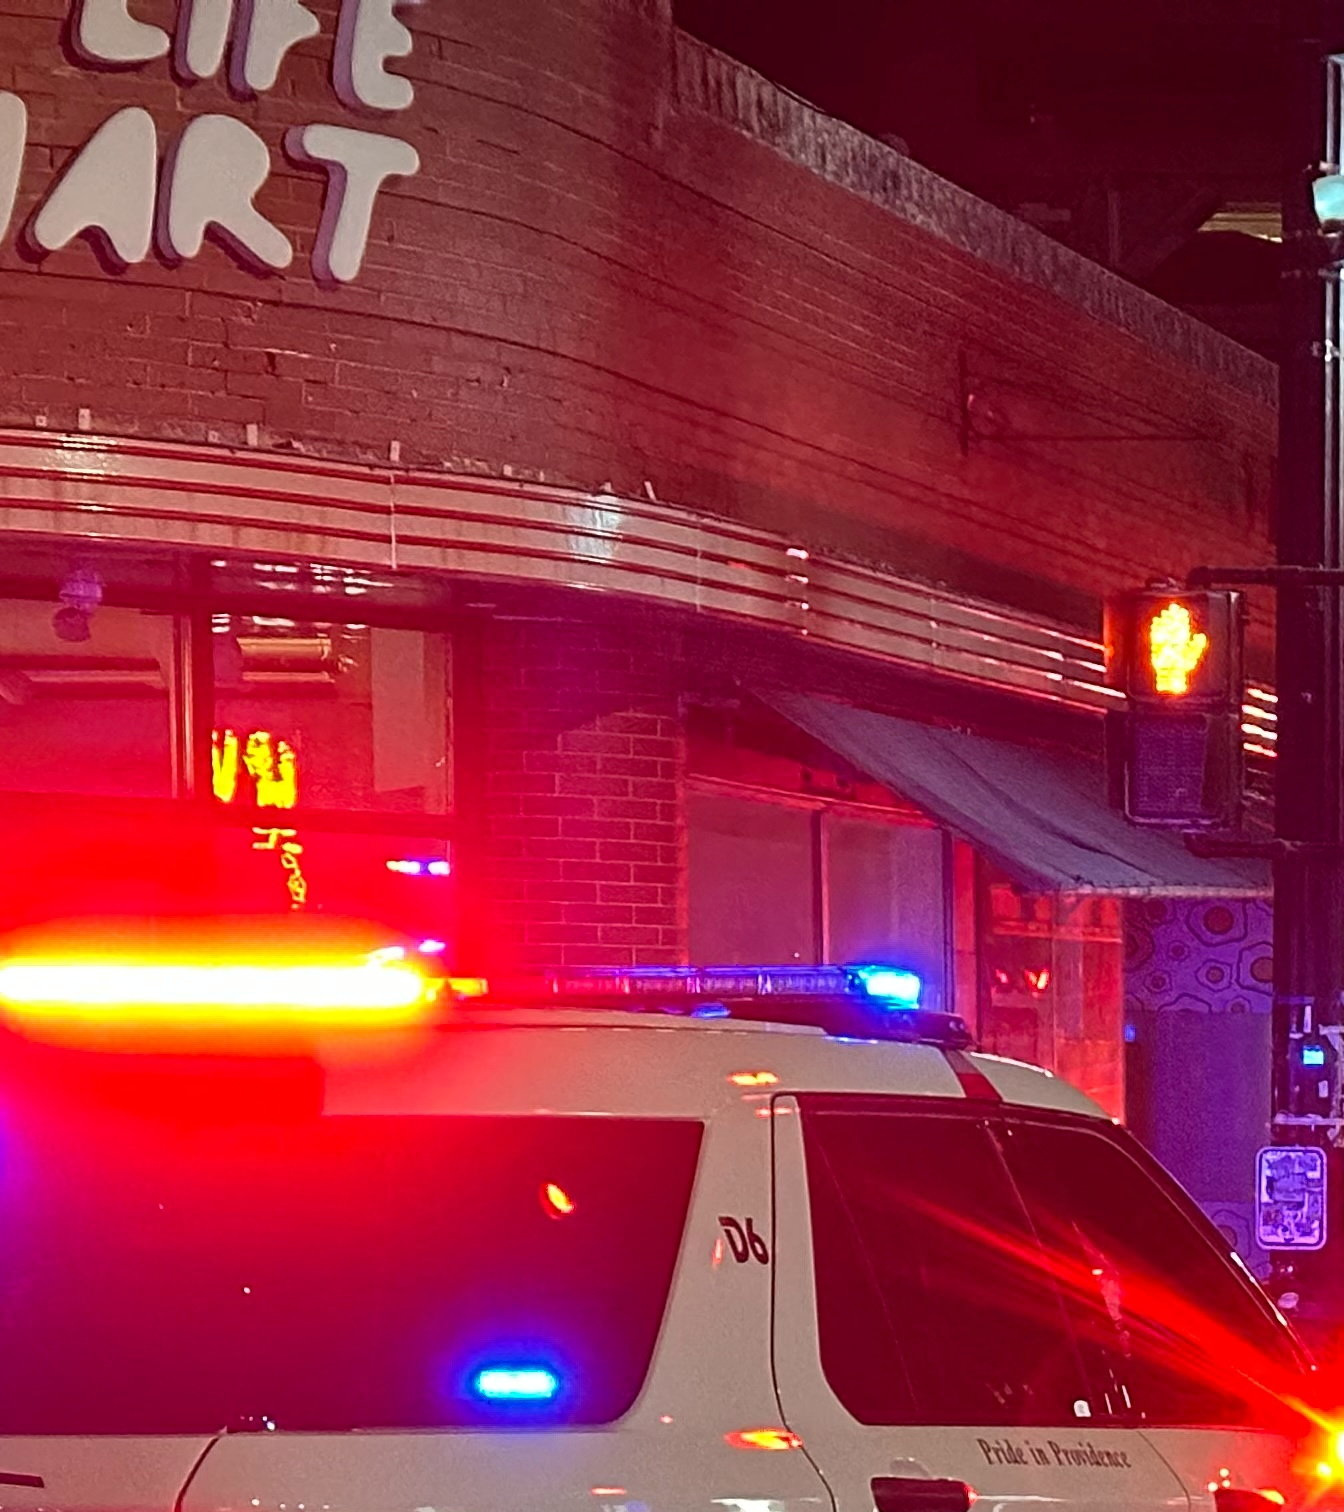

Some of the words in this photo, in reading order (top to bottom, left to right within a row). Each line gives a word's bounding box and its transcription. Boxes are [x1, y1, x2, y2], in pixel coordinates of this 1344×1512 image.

[0, 91, 420, 281] ART
[976, 1438, 1028, 1466] Pride
[1025, 1440, 1051, 1466] in
[1047, 1440, 1133, 1469] Providence
